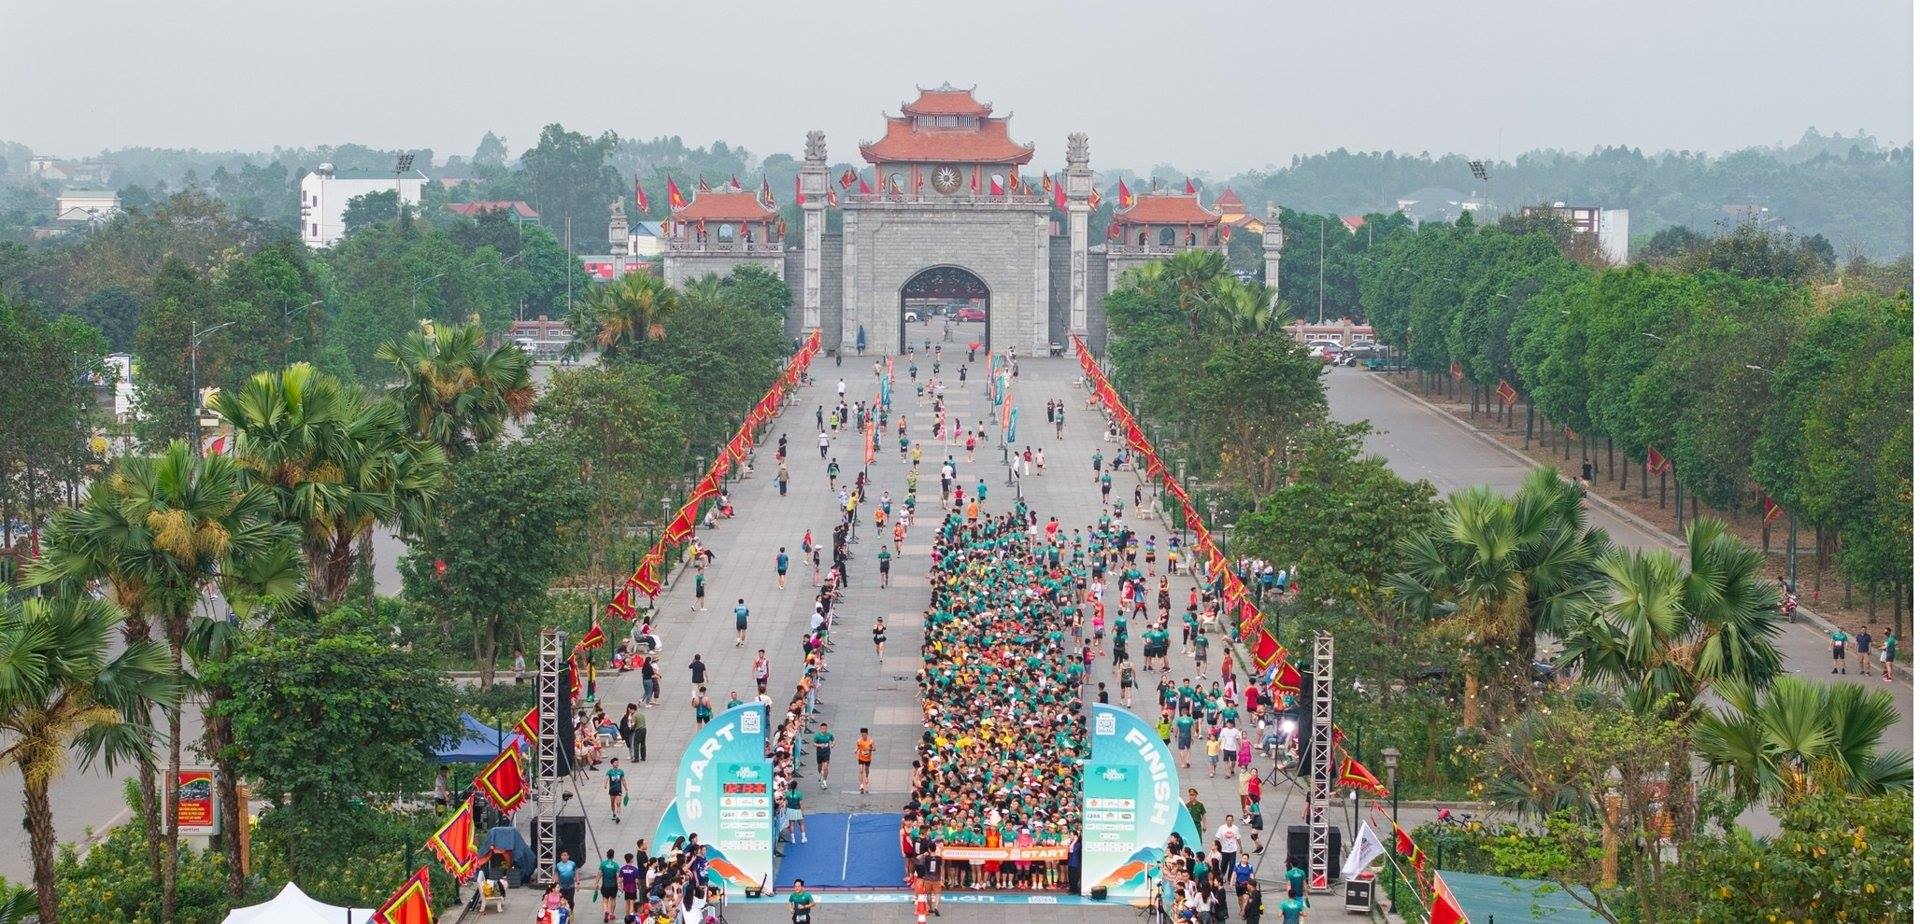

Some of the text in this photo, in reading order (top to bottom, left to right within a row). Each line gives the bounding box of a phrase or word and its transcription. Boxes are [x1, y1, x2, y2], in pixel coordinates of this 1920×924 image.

[684, 722, 735, 820] START
[1124, 727, 1171, 825] FINISH
[1020, 848, 1067, 859] START
